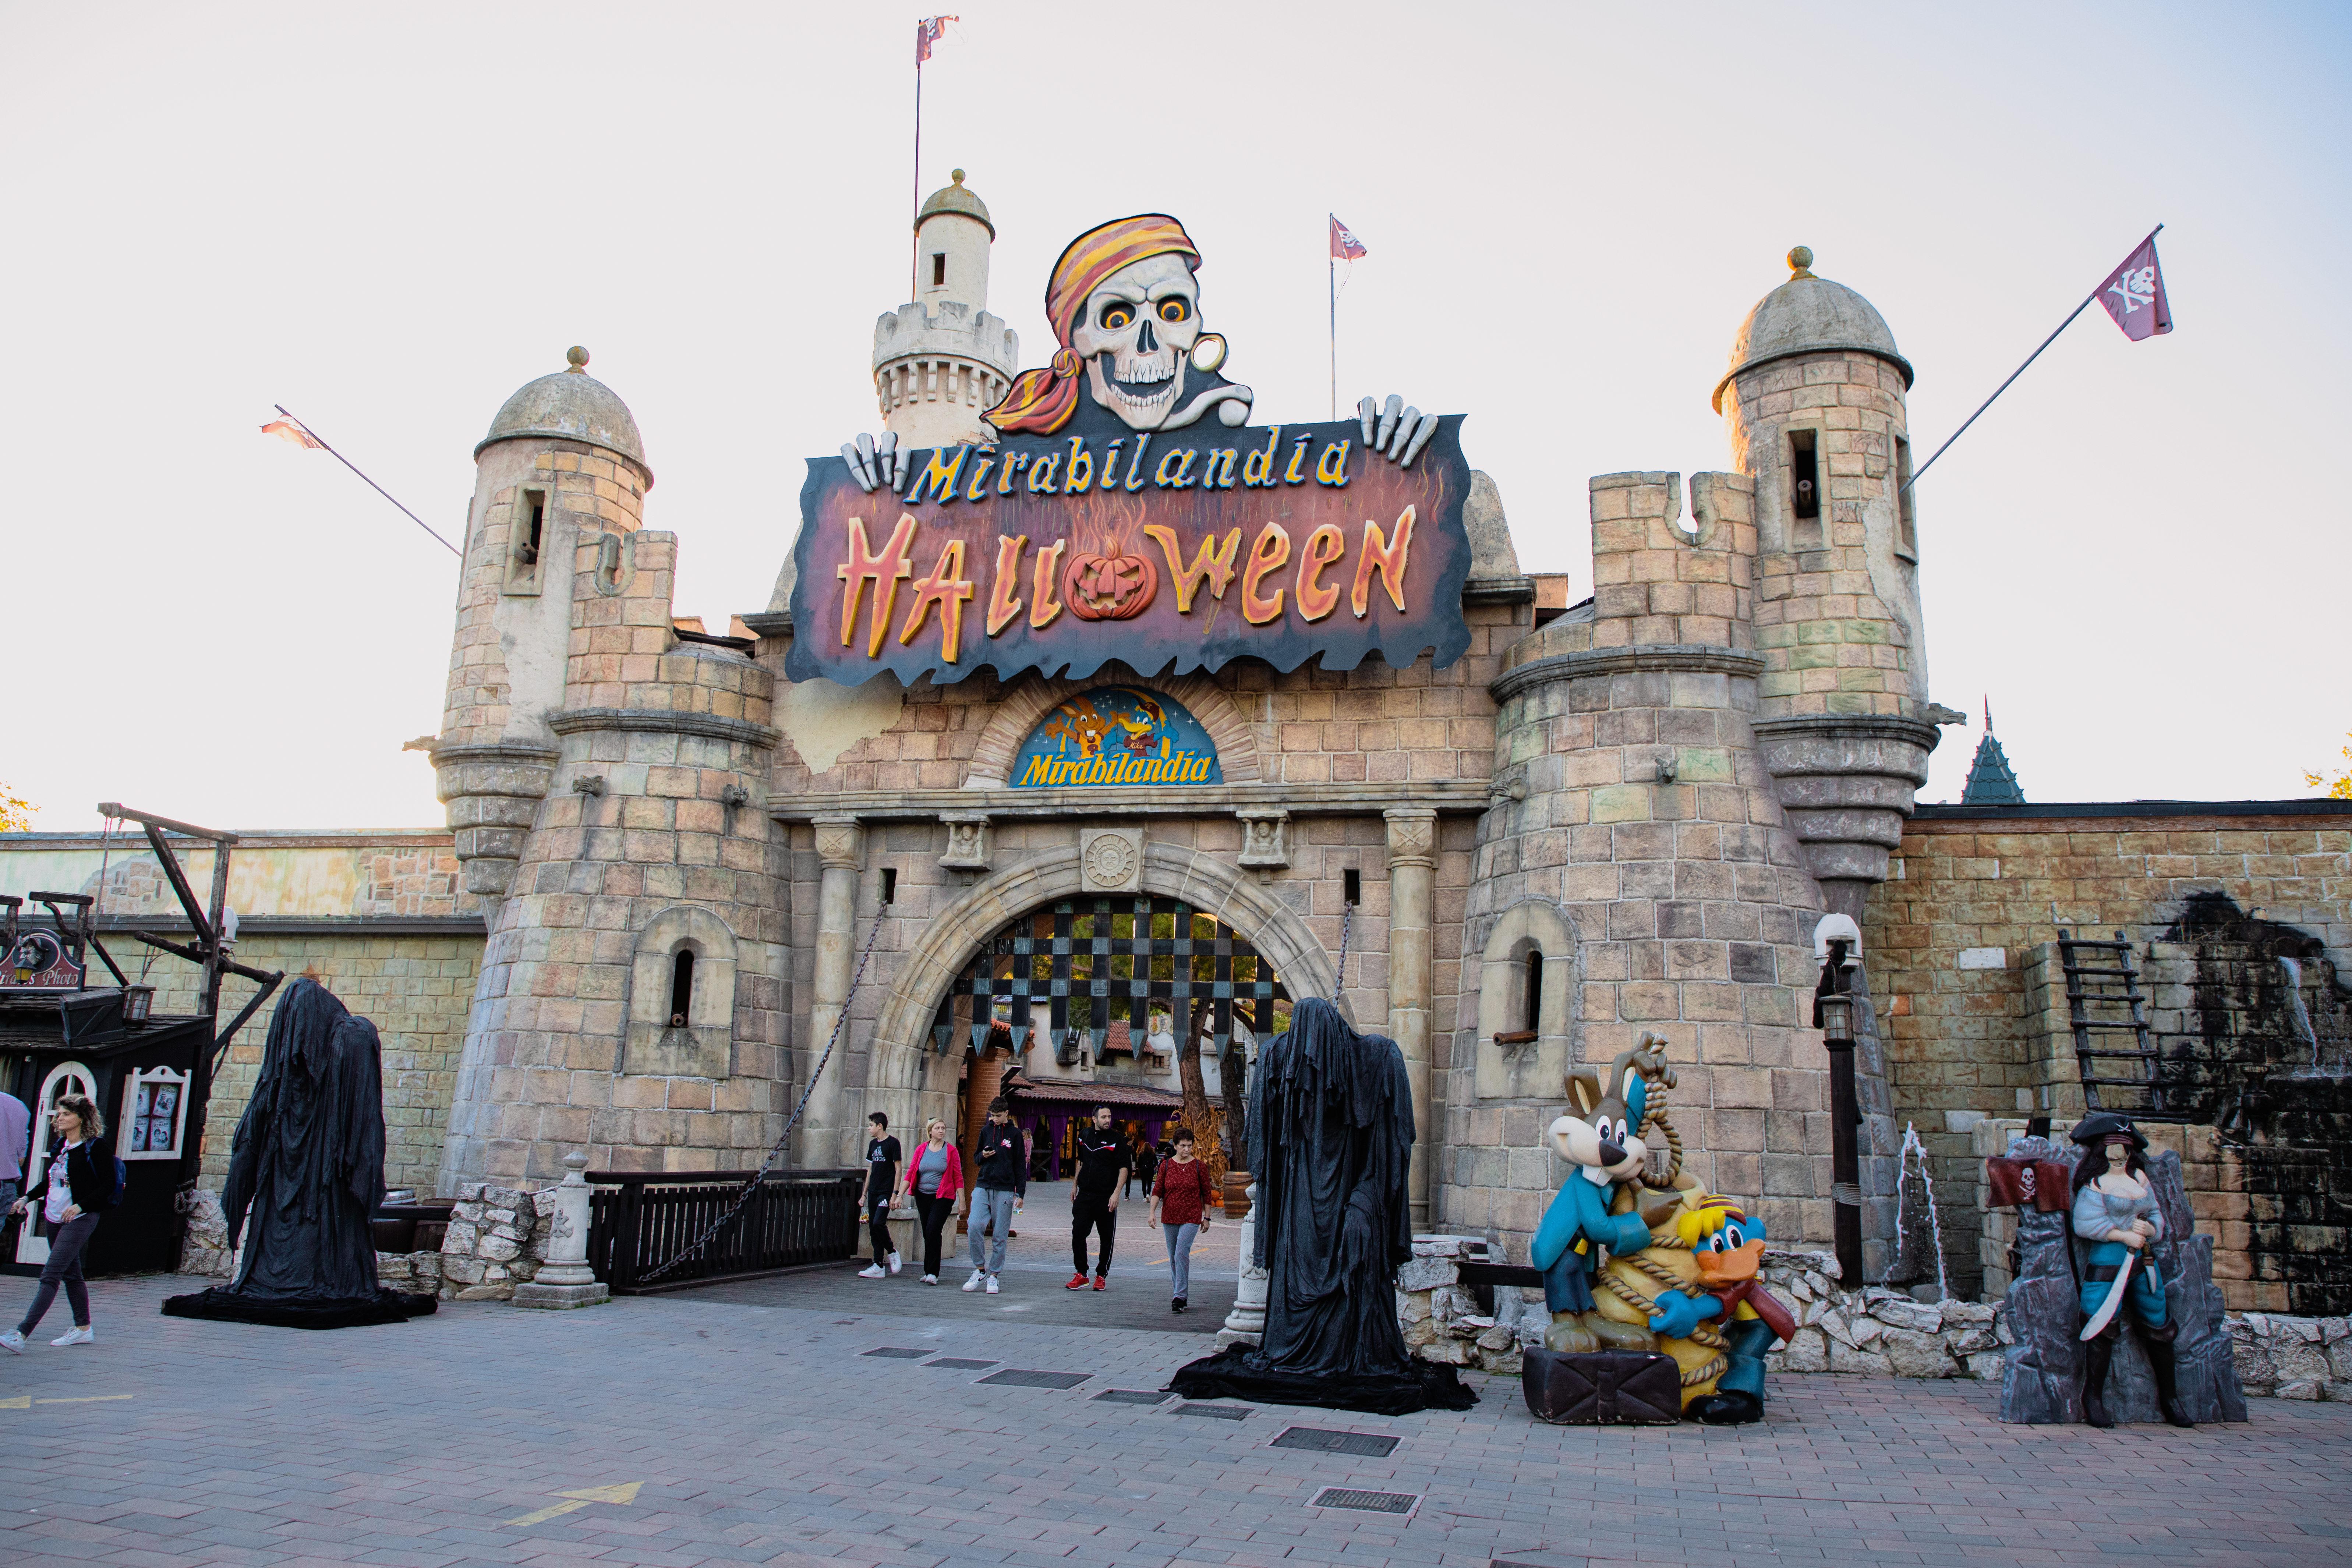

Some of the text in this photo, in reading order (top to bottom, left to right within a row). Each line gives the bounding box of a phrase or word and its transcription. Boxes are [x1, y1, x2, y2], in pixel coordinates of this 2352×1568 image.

[903, 425, 1350, 505] Mirabilandia
[1018, 751, 1212, 786] Mirabilandia
[0, 968, 79, 986] iras Photo
[1242, 1281, 1265, 1296] Village
